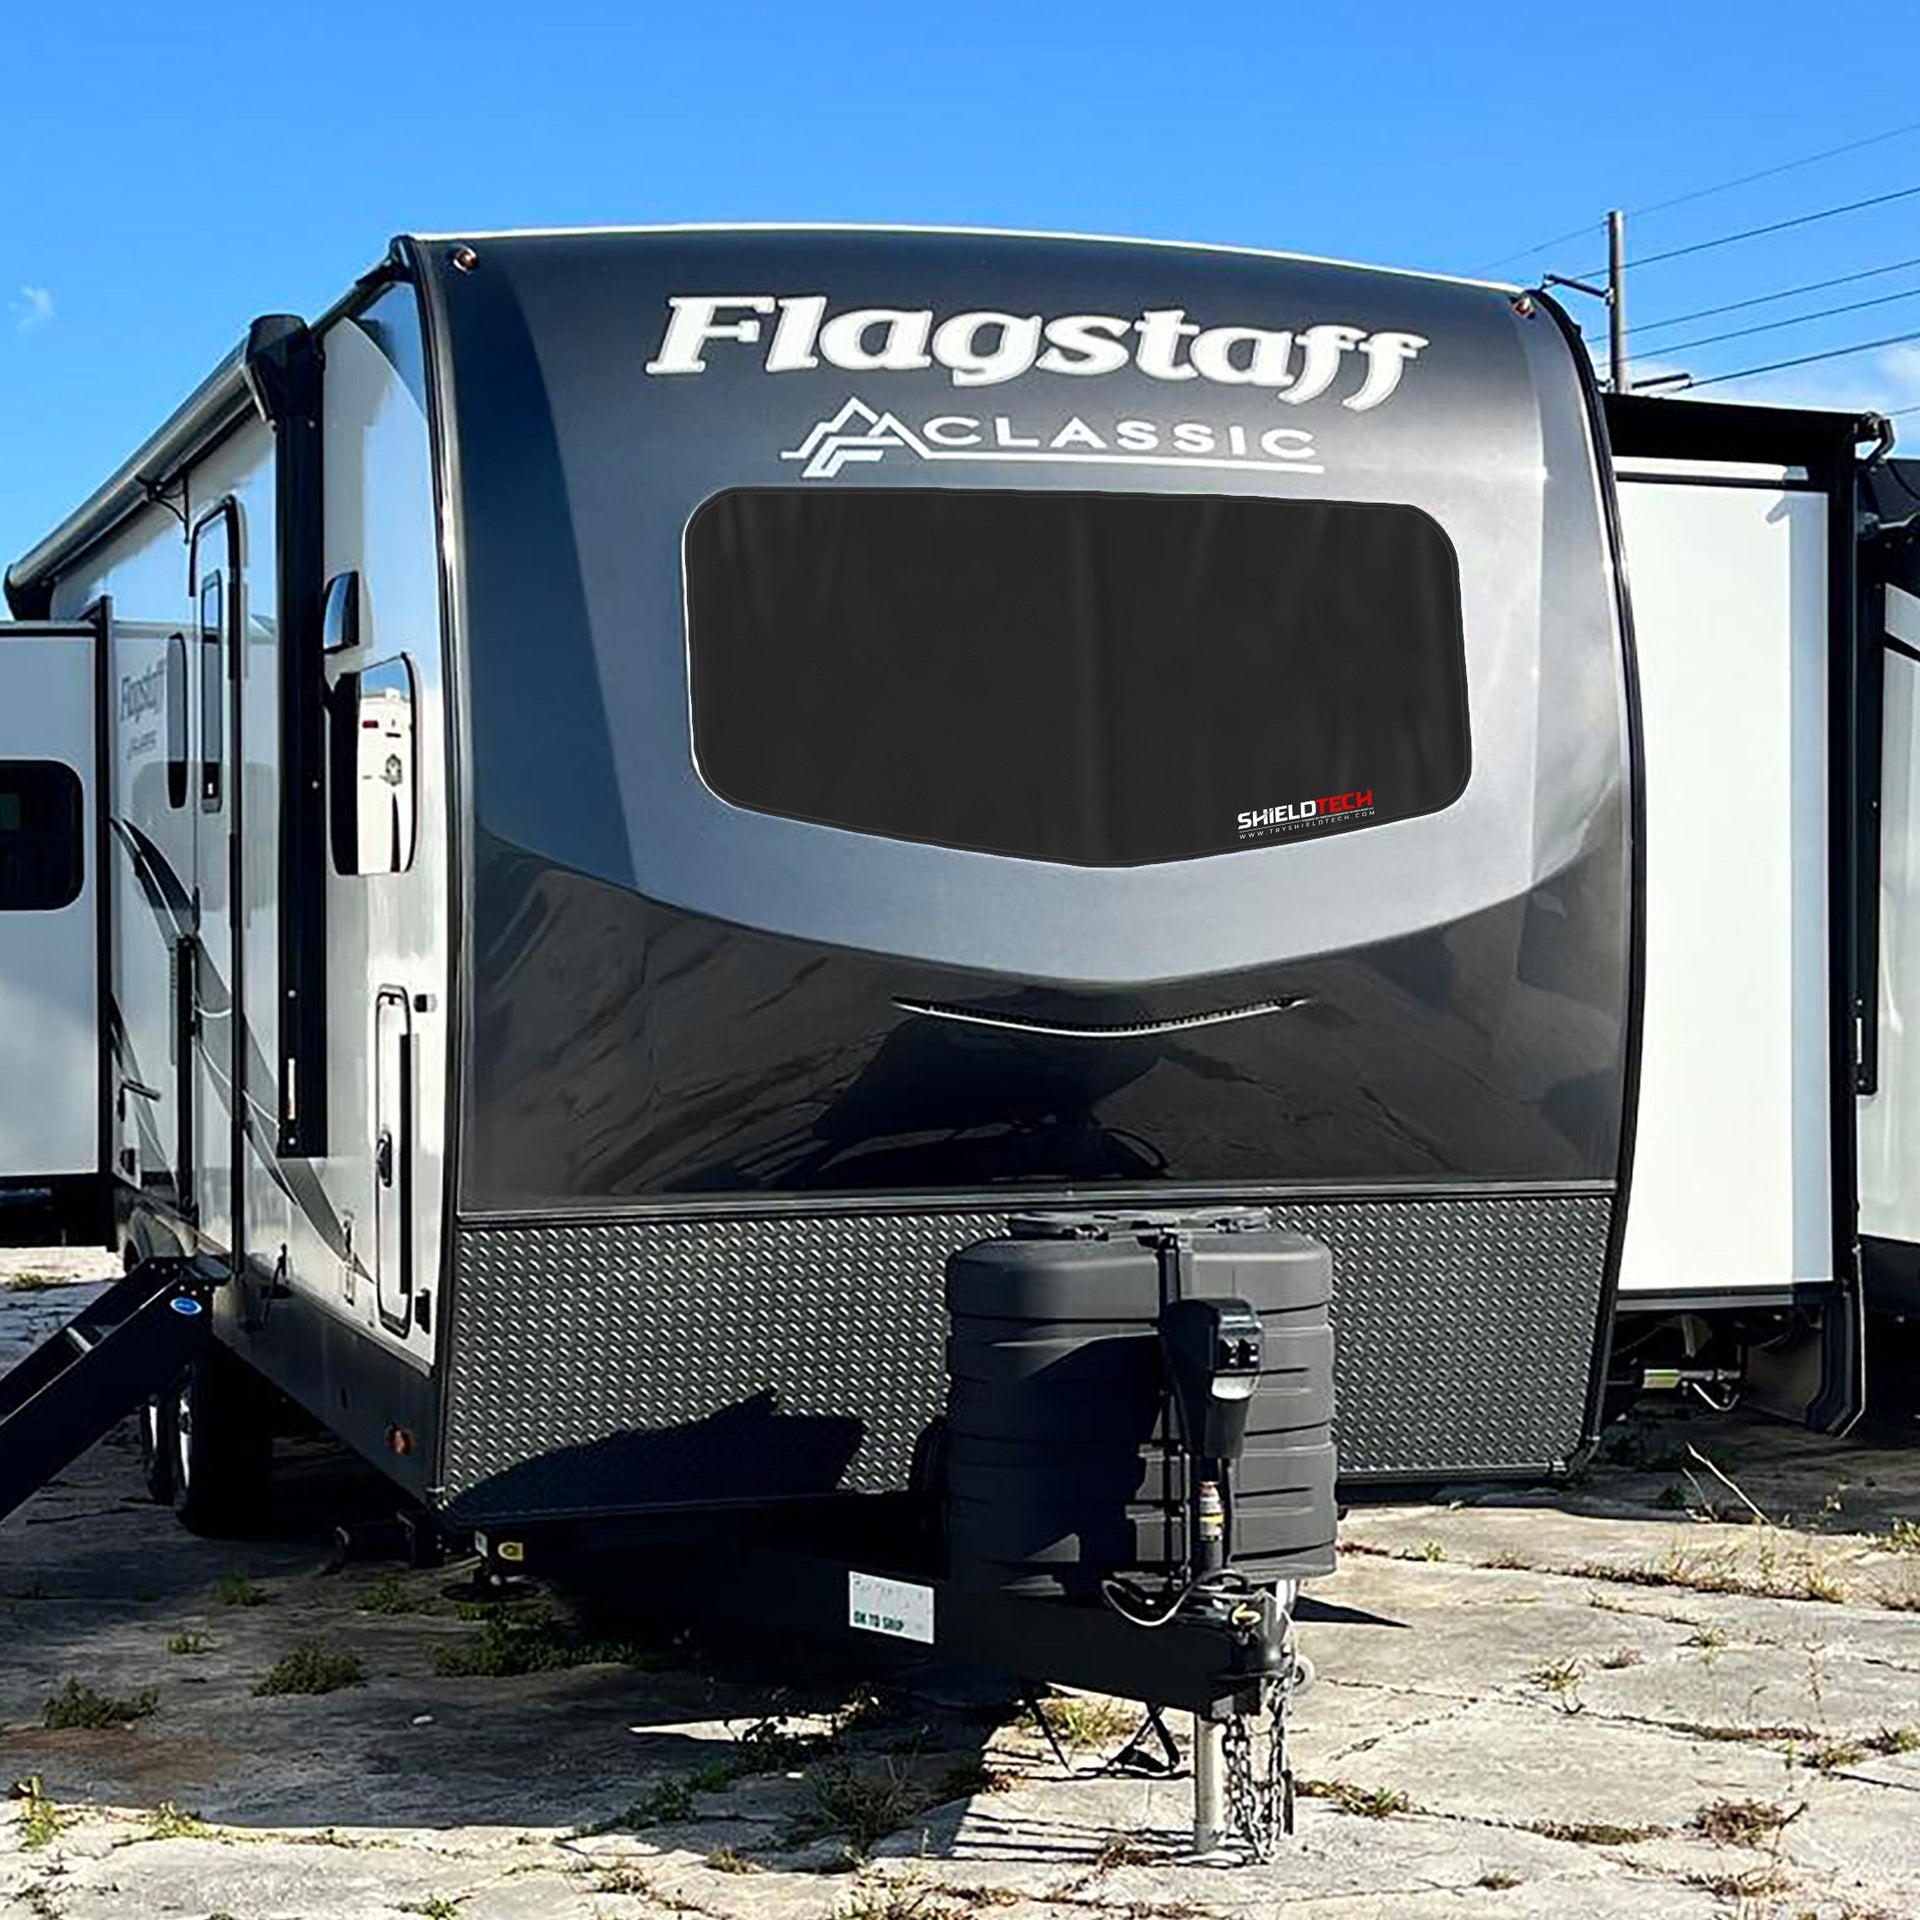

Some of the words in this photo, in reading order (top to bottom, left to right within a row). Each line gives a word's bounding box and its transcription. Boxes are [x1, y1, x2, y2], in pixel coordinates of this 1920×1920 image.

[645, 295, 1429, 411] Flagstaff
[923, 415, 1321, 461] CLASSIC
[1237, 789, 1373, 830] SHIELDTECH
